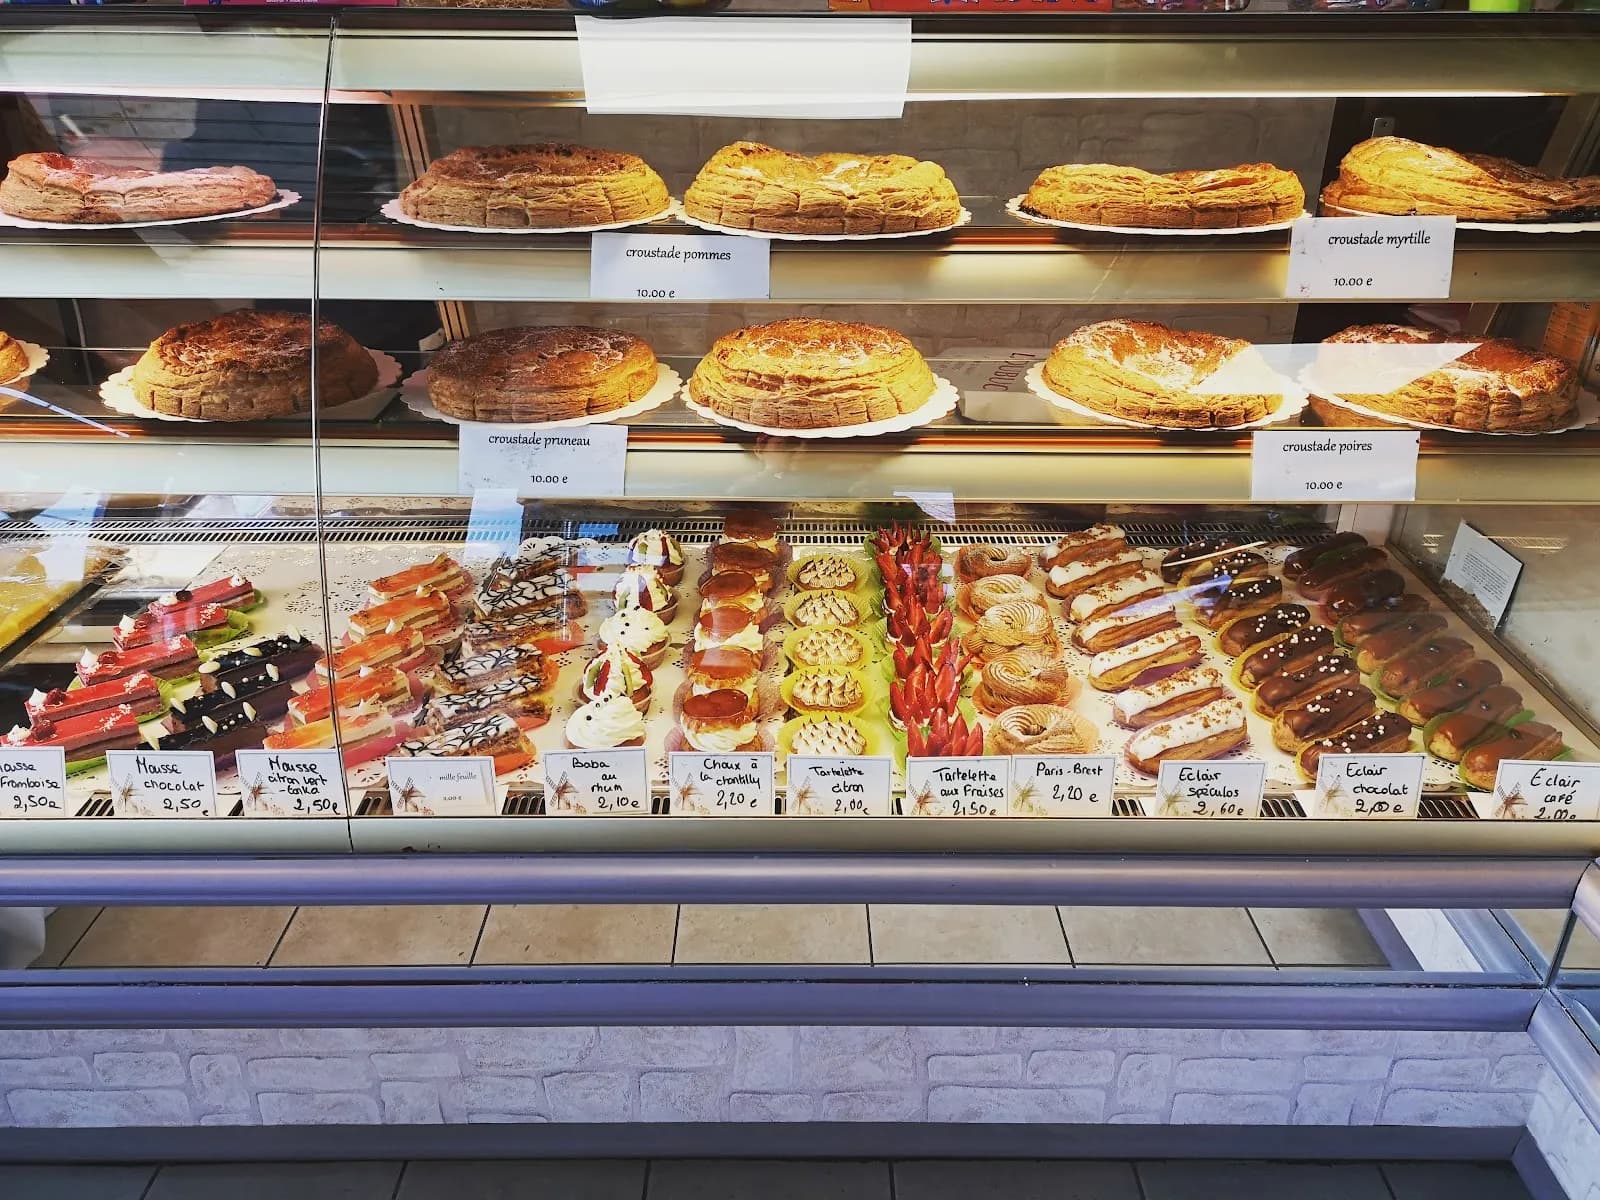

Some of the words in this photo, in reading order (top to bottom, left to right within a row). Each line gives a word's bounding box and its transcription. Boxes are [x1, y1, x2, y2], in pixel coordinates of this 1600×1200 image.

[1328, 231, 1383, 245] croustade
[1386, 230, 1431, 248] myrtille
[625, 246, 680, 259] croustade
[684, 249, 732, 262] pommes
[1334, 278, 1363, 287] 10.00
[637, 289, 666, 298] 10.00
[488, 432, 541, 445] croustade
[544, 437, 590, 448] pruneau
[1282, 438, 1336, 451] croustade
[1339, 439, 1373, 455] poires
[531, 475, 559, 484] 10.00
[1305, 481, 1333, 490] 10.00
[136, 755, 182, 774] Mousse
[268, 755, 319, 774] Mousse
[572, 757, 610, 768] Baba
[703, 758, 740, 770] Choux
[1346, 762, 1388, 777] Eclair
[268, 772, 300, 784] citron
[303, 774, 328, 786] vert
[439, 772, 455, 781] mille
[456, 771, 477, 782] feuille
[700, 771, 712, 781] la
[716, 773, 761, 789] chantilly
[932, 767, 996, 781] Tartelette
[1179, 767, 1221, 781] Eclair
[1530, 768, 1580, 788] Eclair
[0, 776, 60, 789] Framboise
[144, 780, 204, 791] chocolat
[591, 783, 623, 792] rhum
[1353, 782, 1408, 795] chocolat
[940, 788, 959, 797] aux
[964, 784, 1004, 798] Fraises
[1052, 784, 1083, 802] 2,20
[1187, 784, 1240, 798] spéculos
[1544, 790, 1577, 804] café
[716, 790, 745, 810] 2,20
